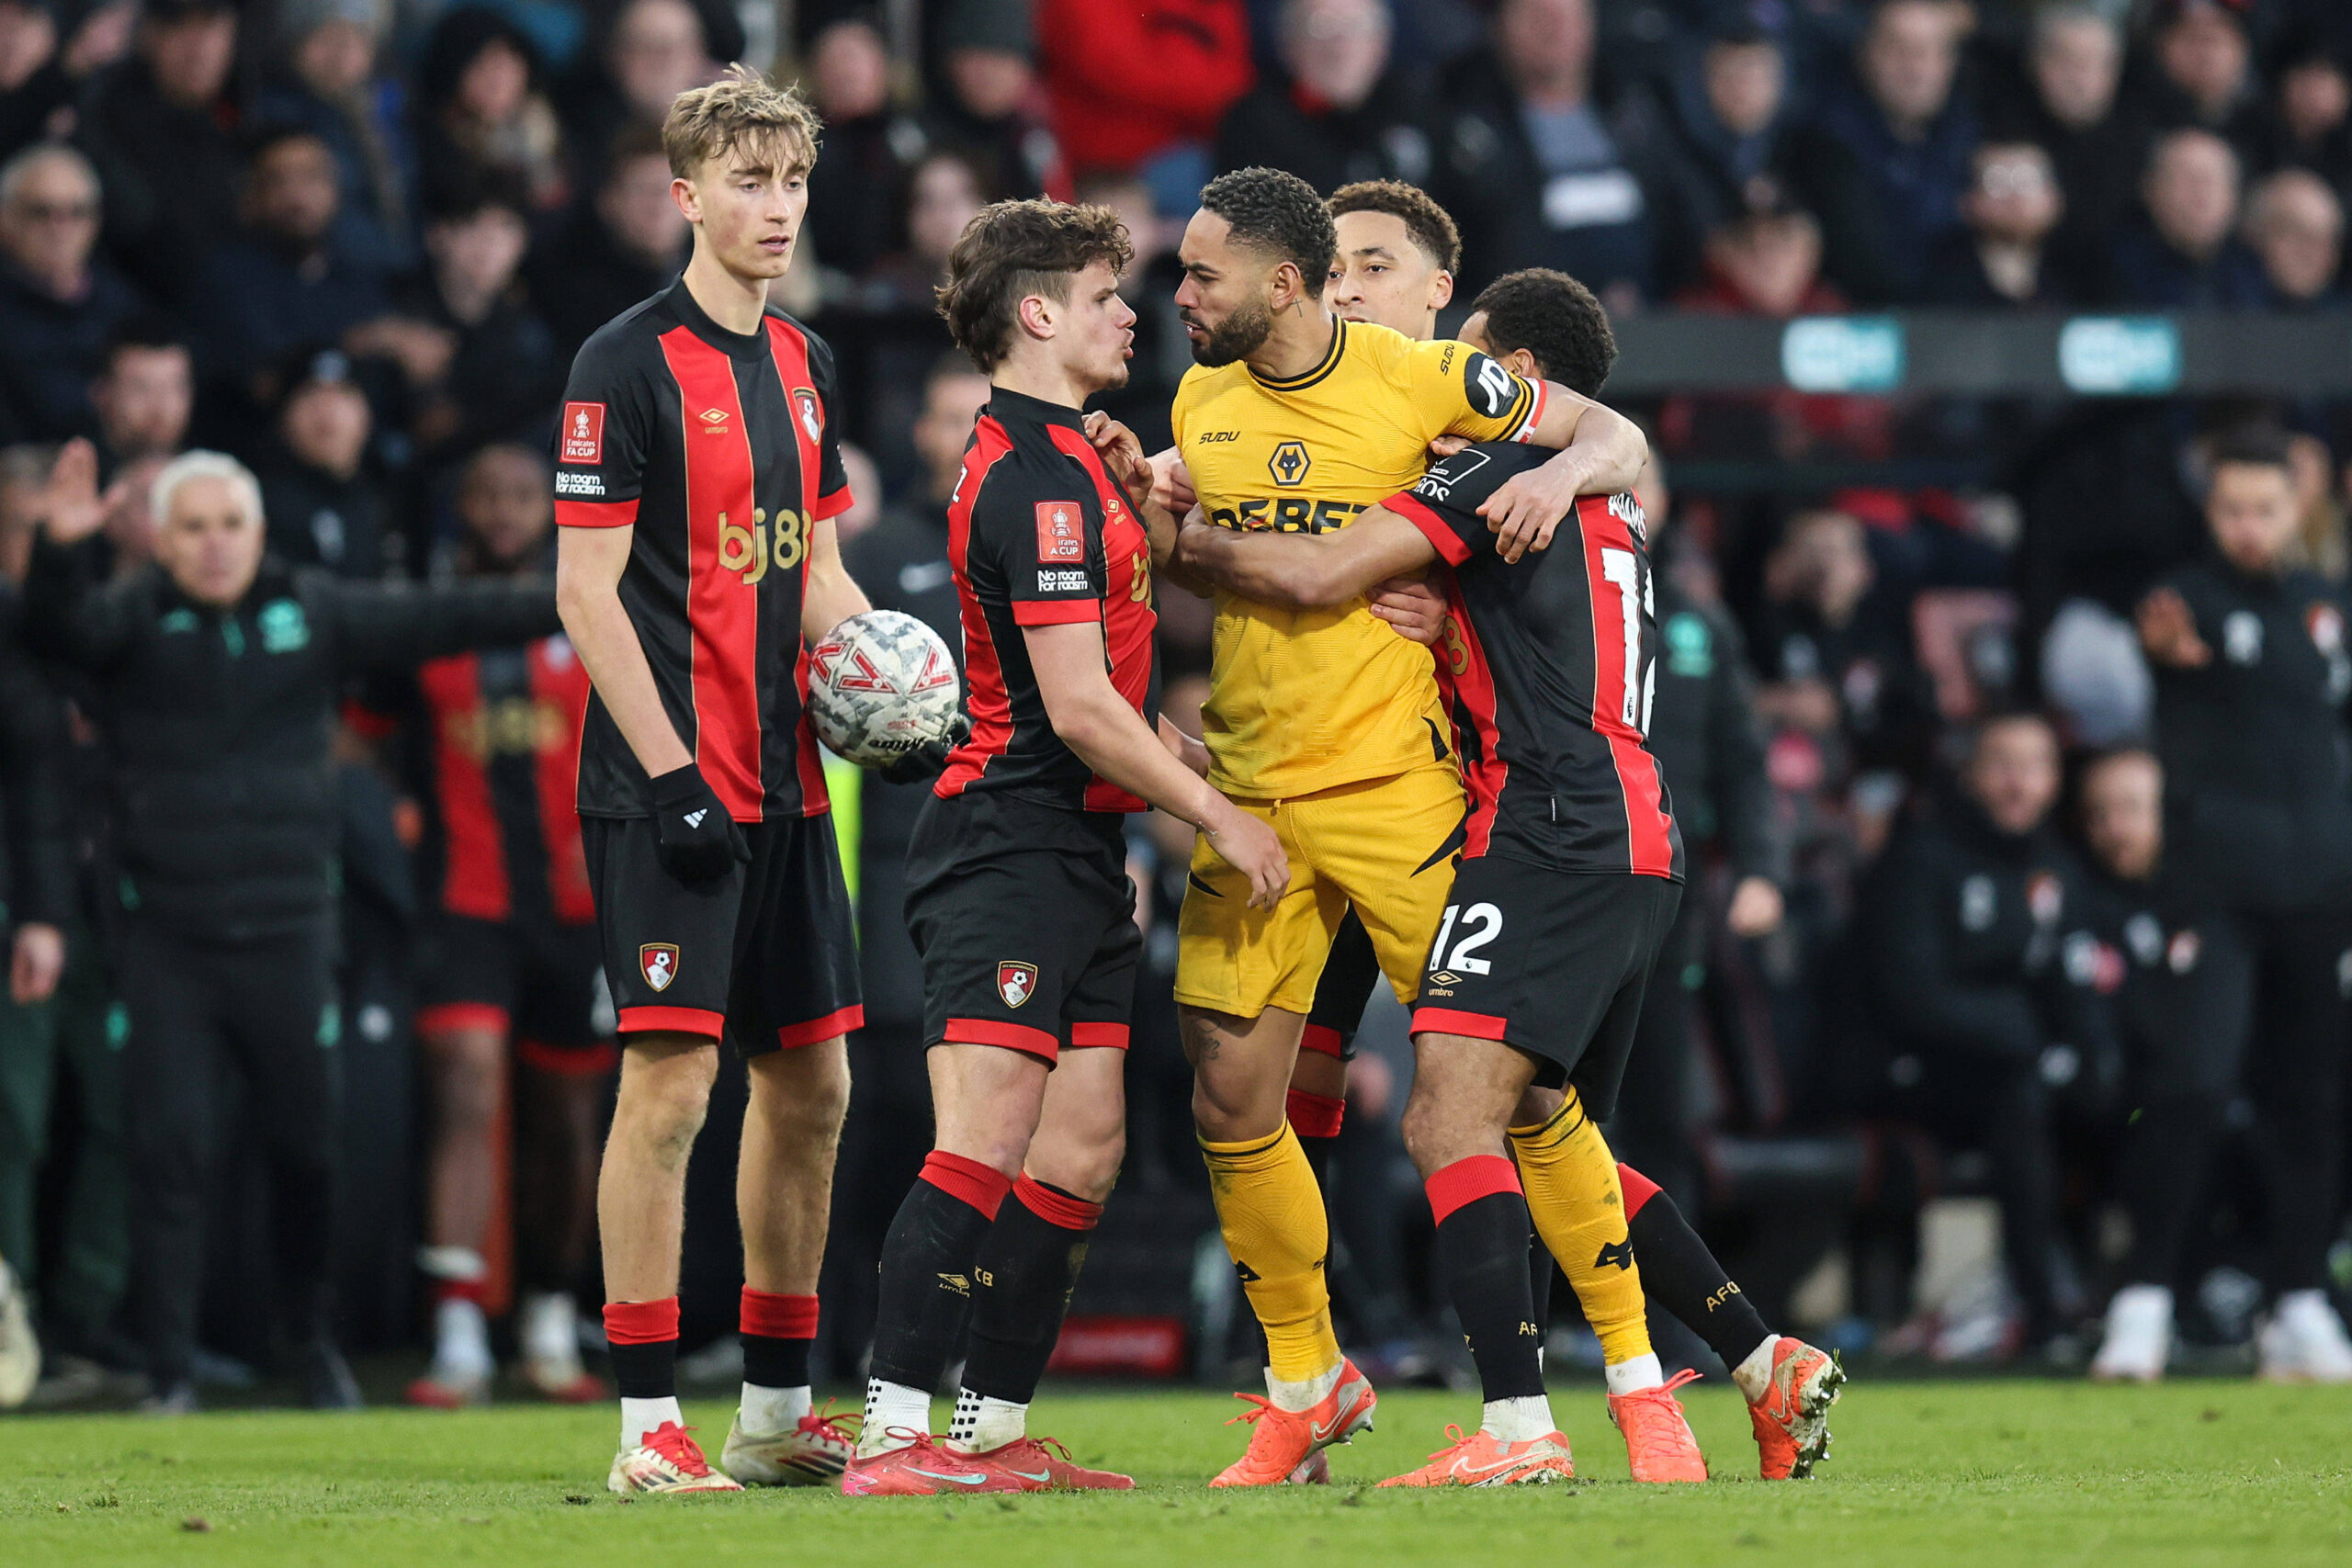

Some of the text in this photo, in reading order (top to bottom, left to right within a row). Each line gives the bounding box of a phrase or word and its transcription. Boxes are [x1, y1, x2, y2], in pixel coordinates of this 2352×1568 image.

[1476, 357, 1510, 415] JD
[566, 438, 596, 448] Emirates
[1198, 431, 1240, 446] SUDU
[566, 446, 596, 457] FA CUP
[556, 471, 601, 486] No room
[555, 482, 605, 496] for racism
[1211, 499, 1370, 535] DEBE
[1058, 547, 1079, 556] CUP
[1037, 570, 1085, 582] No room
[1038, 580, 1088, 592] for racism
[1428, 902, 1503, 976] 12
[1428, 987, 1454, 998] umbro
[974, 1265, 994, 1287] CB
[1706, 1280, 1742, 1314] AFC
